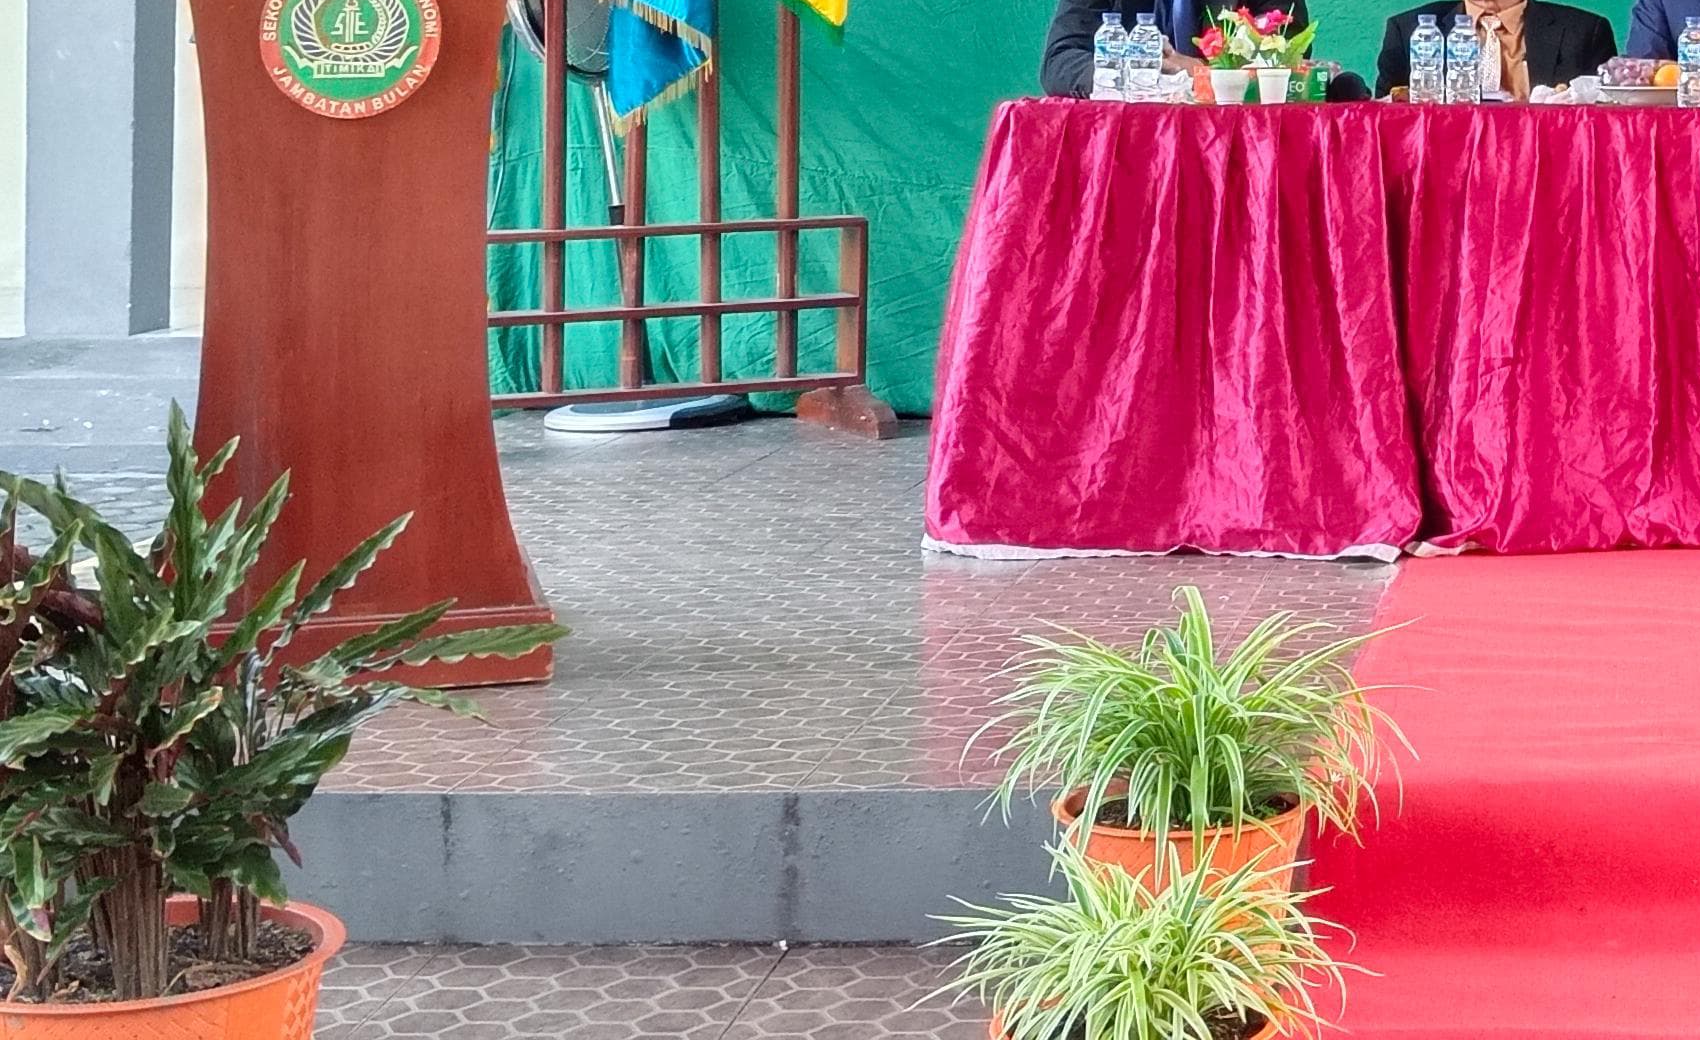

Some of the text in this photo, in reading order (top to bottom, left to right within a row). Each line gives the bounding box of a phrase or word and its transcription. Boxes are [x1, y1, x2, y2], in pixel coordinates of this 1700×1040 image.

[325, 63, 378, 73] TIMIKA
[272, 64, 427, 114] JAMBATAN BULAN
